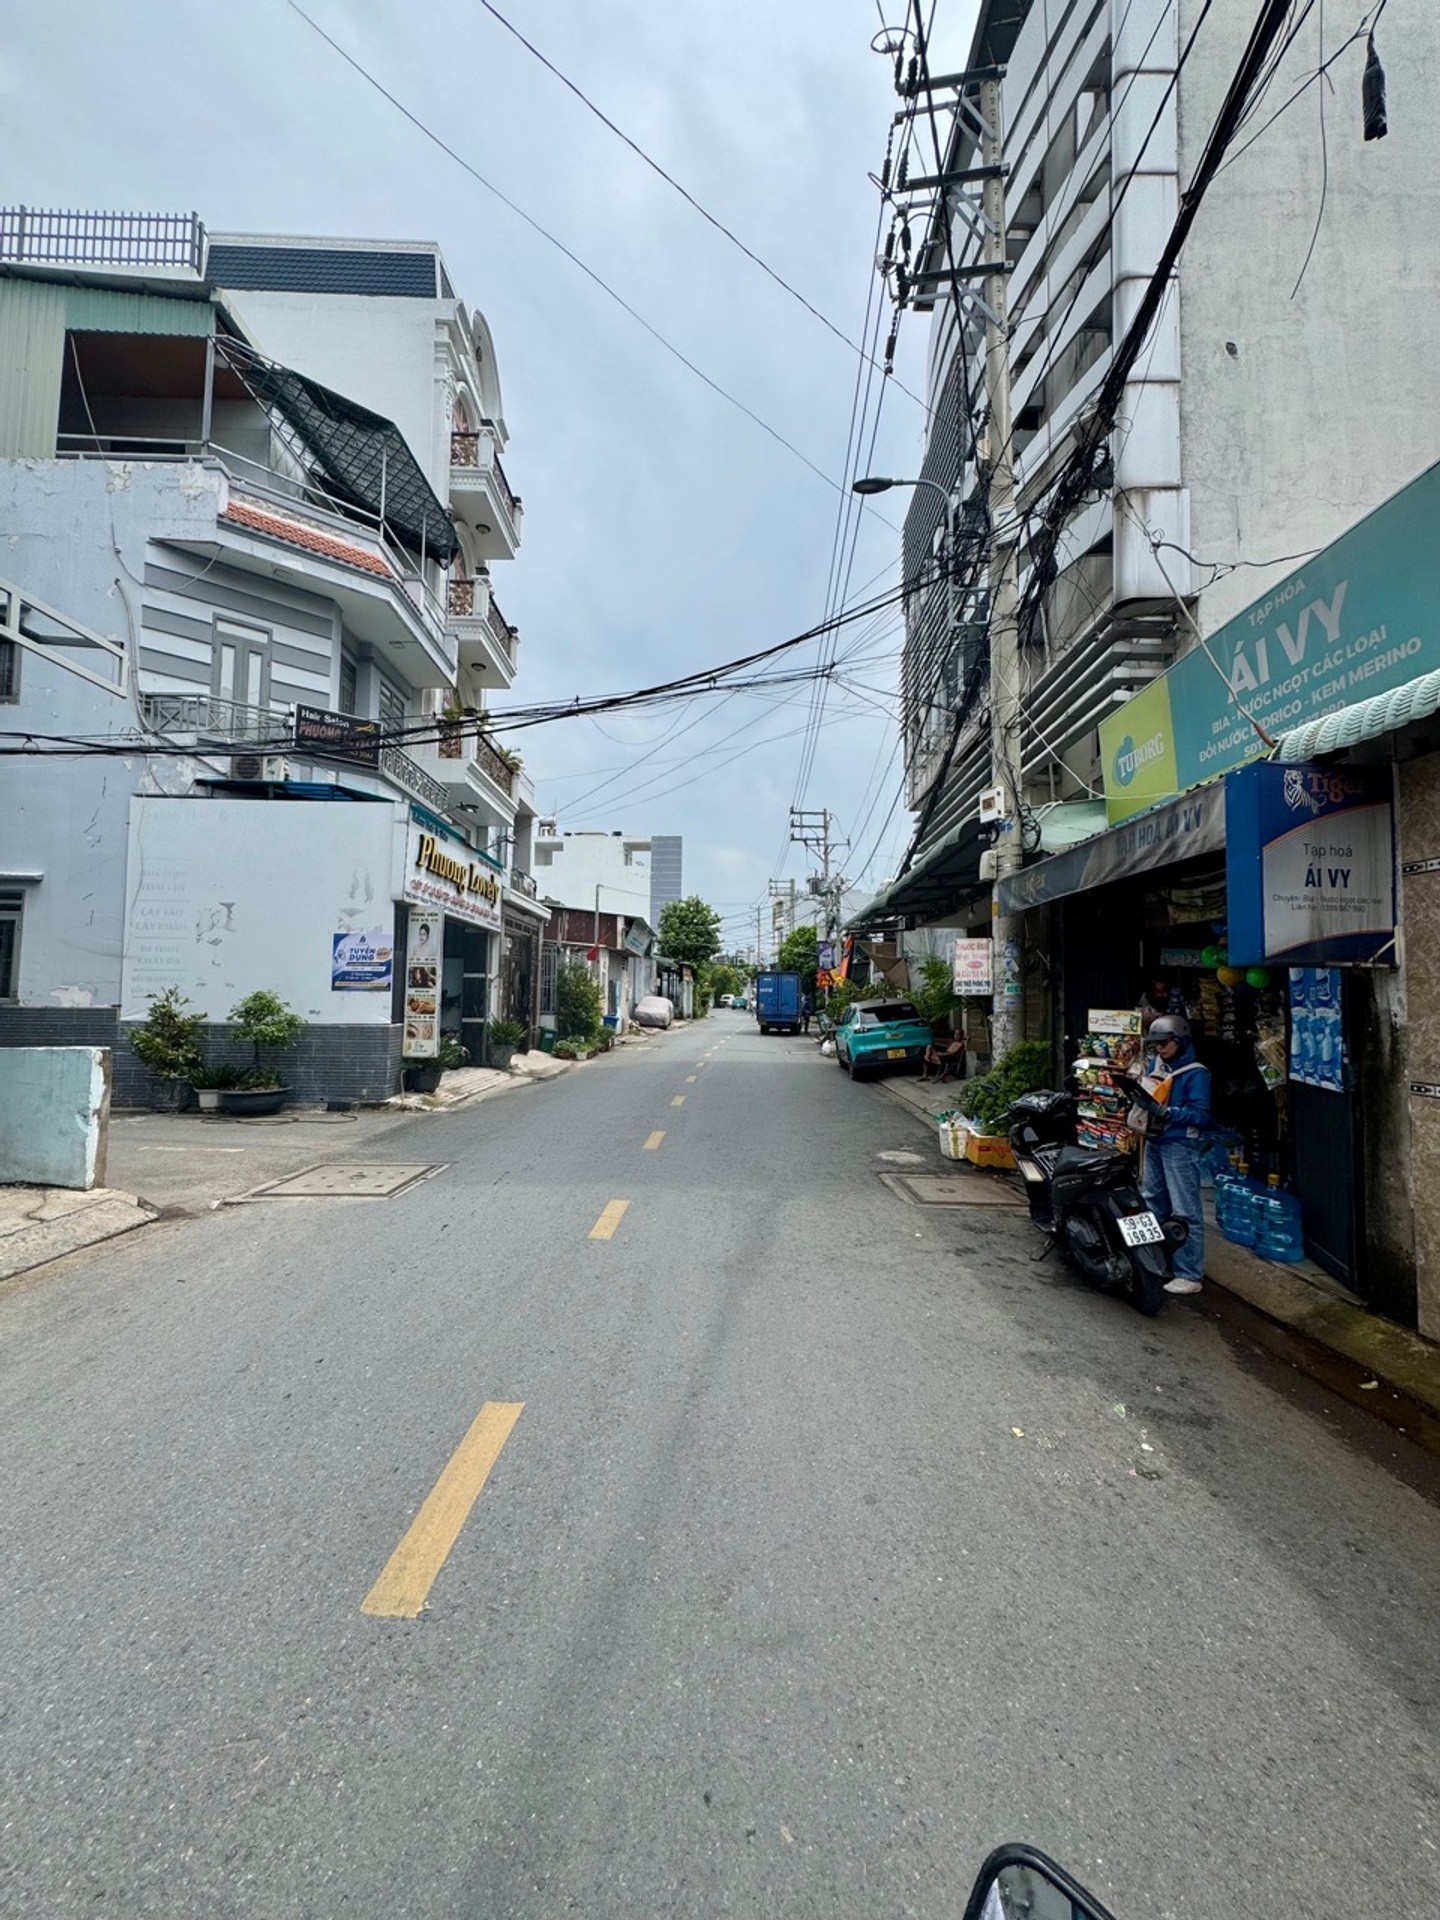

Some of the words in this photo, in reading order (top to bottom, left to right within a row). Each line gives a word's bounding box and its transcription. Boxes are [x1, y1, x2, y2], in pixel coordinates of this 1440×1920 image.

[1248, 602, 1275, 626] TẠP
[1274, 578, 1306, 611] HÓA
[1275, 580, 1349, 666] VY
[1212, 716, 1231, 735] BIA
[1272, 669, 1310, 699] NGỌT
[1311, 649, 1344, 677] CÁC
[1346, 624, 1387, 660] LOẠI
[1311, 678, 1347, 706] KEM
[1348, 635, 1423, 688] MERINO
[301, 709, 321, 721] Hair
[1117, 731, 1165, 778] TUBORG
[1307, 771, 1364, 803] Tiger
[1304, 862, 1322, 888] ÁI
[1327, 868, 1351, 889] VY
